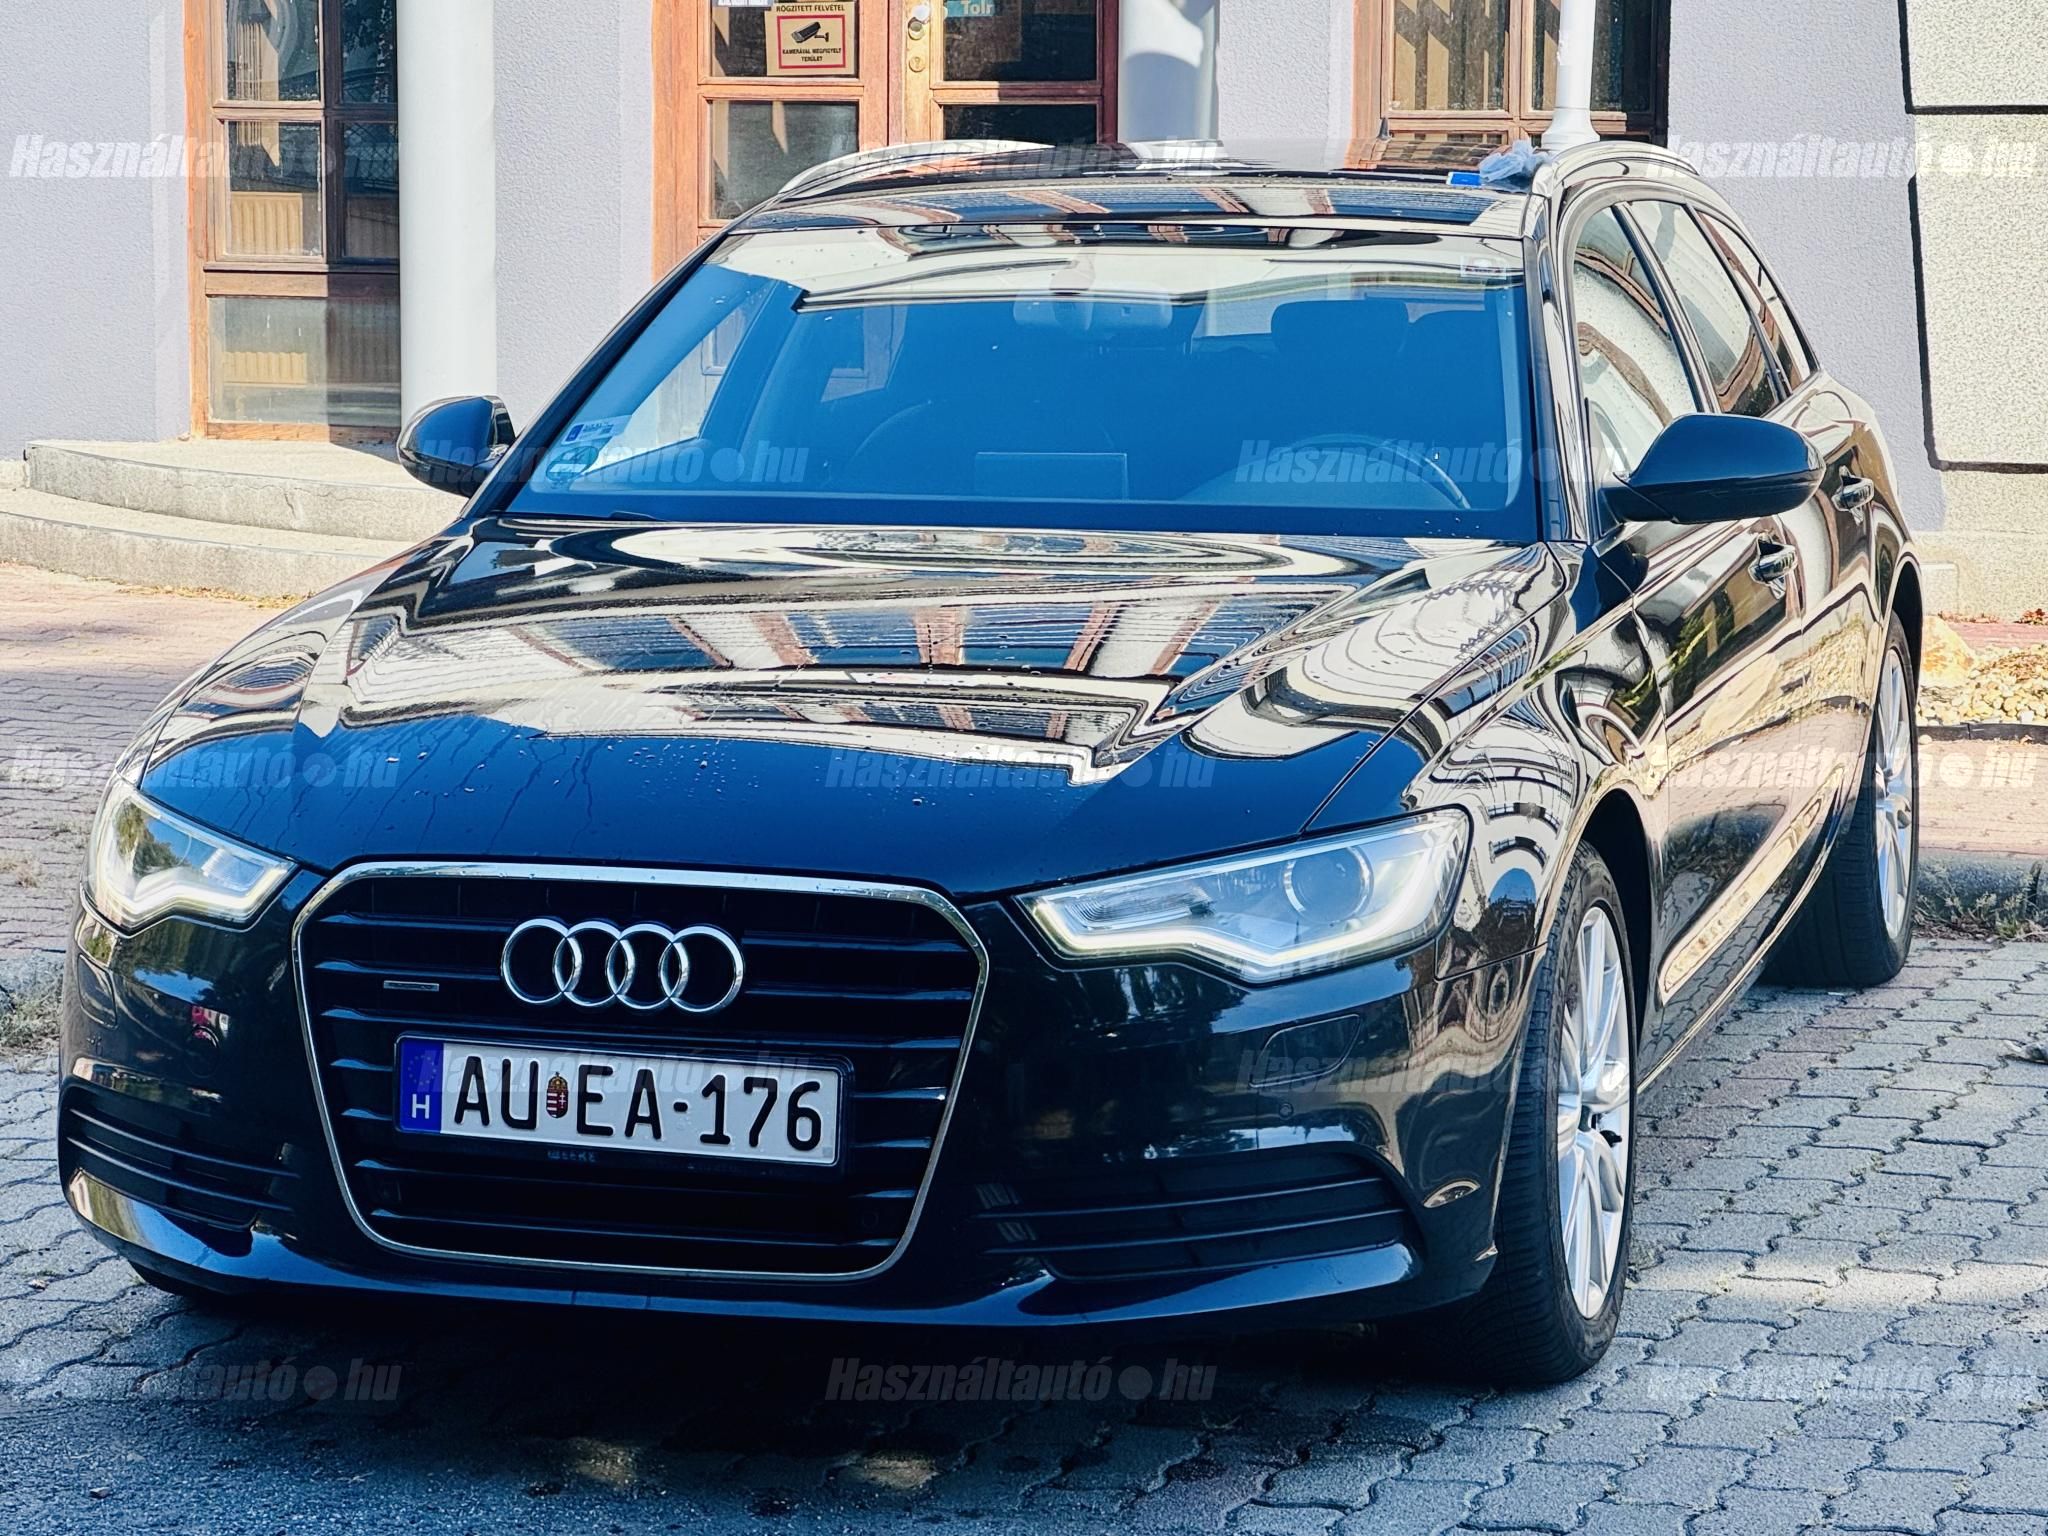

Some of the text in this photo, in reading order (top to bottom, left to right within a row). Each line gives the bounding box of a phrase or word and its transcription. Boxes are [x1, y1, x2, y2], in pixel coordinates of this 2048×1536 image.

[814, 4, 845, 12] FELVÉTEL
[411, 1056, 822, 1152] H AU EA-176
